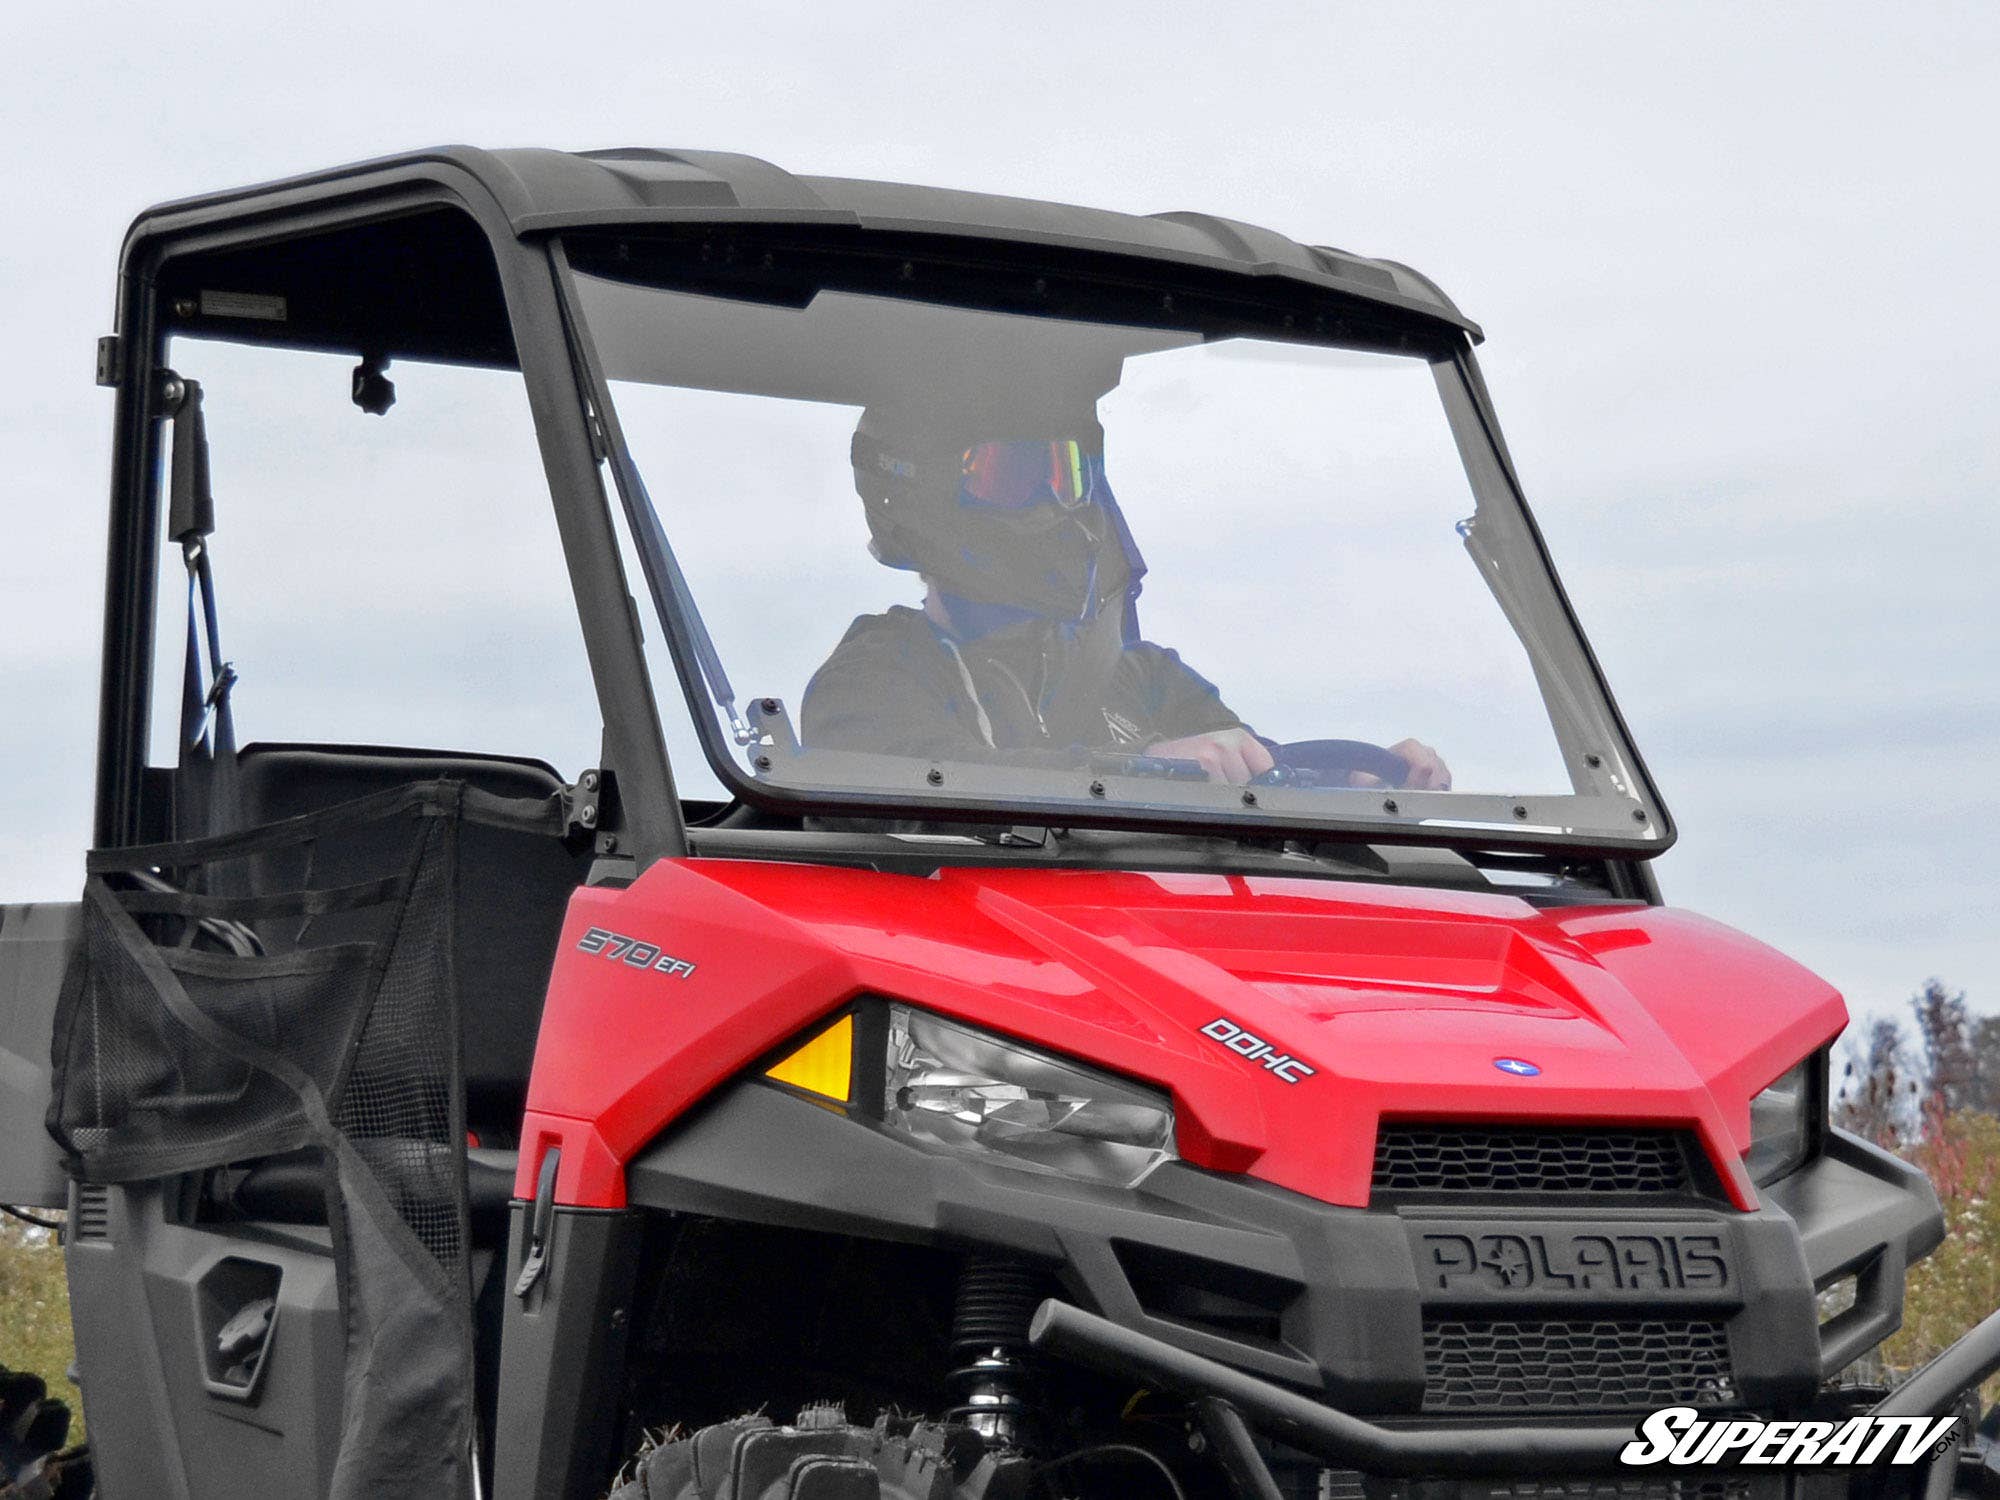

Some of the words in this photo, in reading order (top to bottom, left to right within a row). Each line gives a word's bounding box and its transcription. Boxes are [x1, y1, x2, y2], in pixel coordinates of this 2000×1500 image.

[576, 926, 662, 969] 570
[653, 955, 696, 979] EFI
[1199, 1017, 1317, 1084] DOHC
[1422, 1233, 1729, 1290] POLARIS
